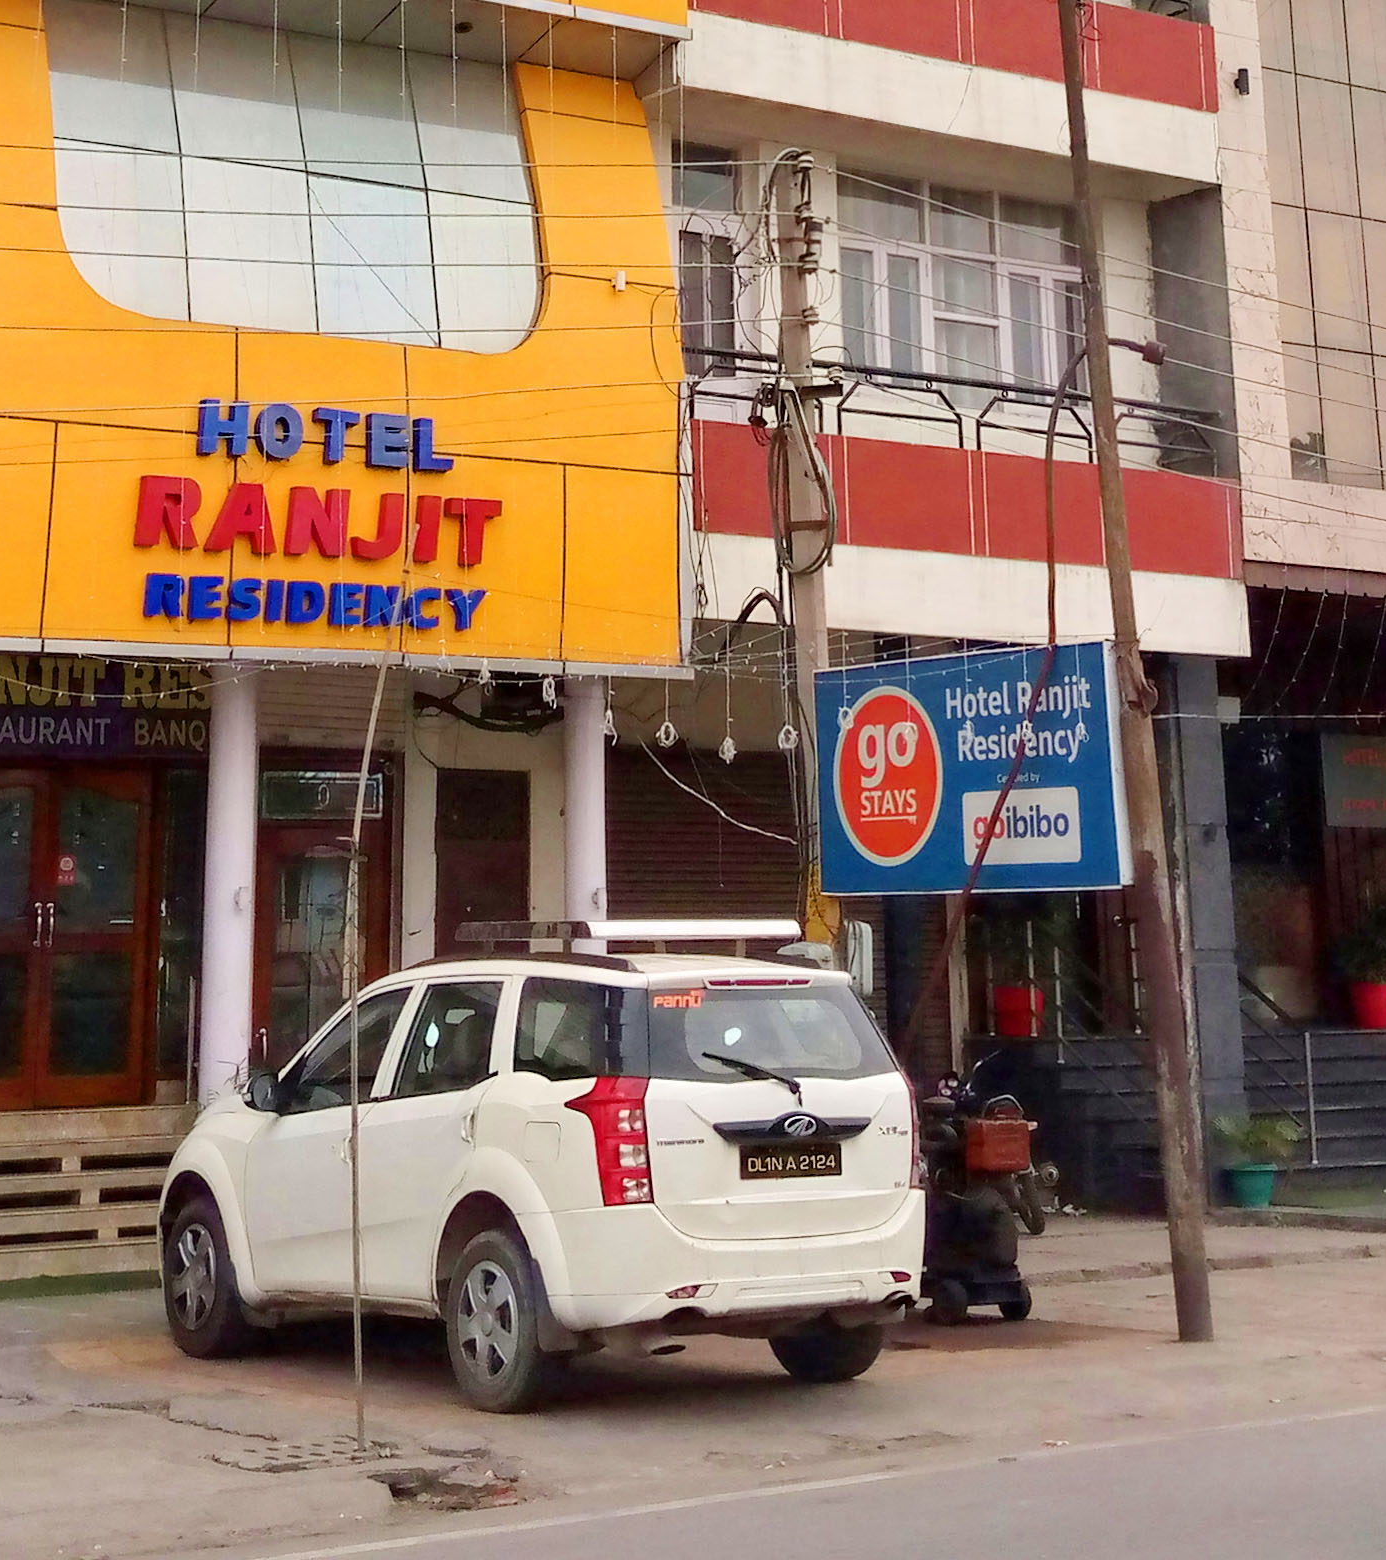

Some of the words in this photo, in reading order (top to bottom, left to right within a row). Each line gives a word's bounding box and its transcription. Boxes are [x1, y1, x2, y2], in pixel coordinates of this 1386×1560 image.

[195, 398, 455, 474] HOTEL
[133, 474, 503, 567] RANJIT
[142, 571, 487, 631] RESIDENCY
[945, 680, 1012, 720] Hotel
[1016, 674, 1091, 720] Ranjit
[857, 721, 918, 789] go
[957, 723, 1081, 764] Residency
[859, 788, 918, 816] STAYS
[973, 804, 1070, 850] goibibo
[748, 1156, 783, 1173] DL1N
[785, 1155, 797, 1171] A
[799, 1154, 836, 1171] 2124
